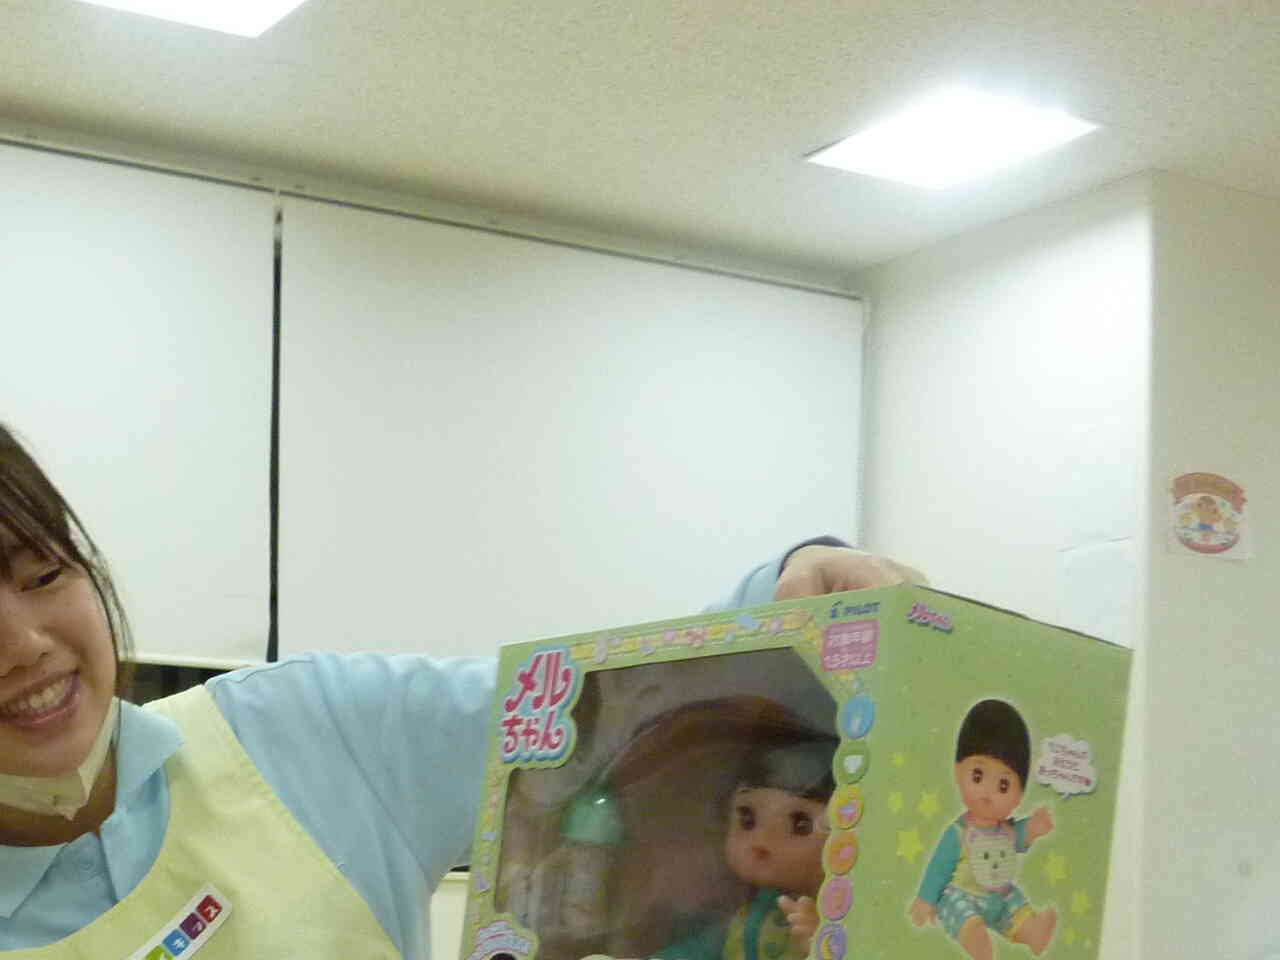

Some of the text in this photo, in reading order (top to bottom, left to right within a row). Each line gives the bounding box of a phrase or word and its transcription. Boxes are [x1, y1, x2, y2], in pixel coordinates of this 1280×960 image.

[503, 649, 573, 713] メル
[500, 711, 566, 755] ちゃん
